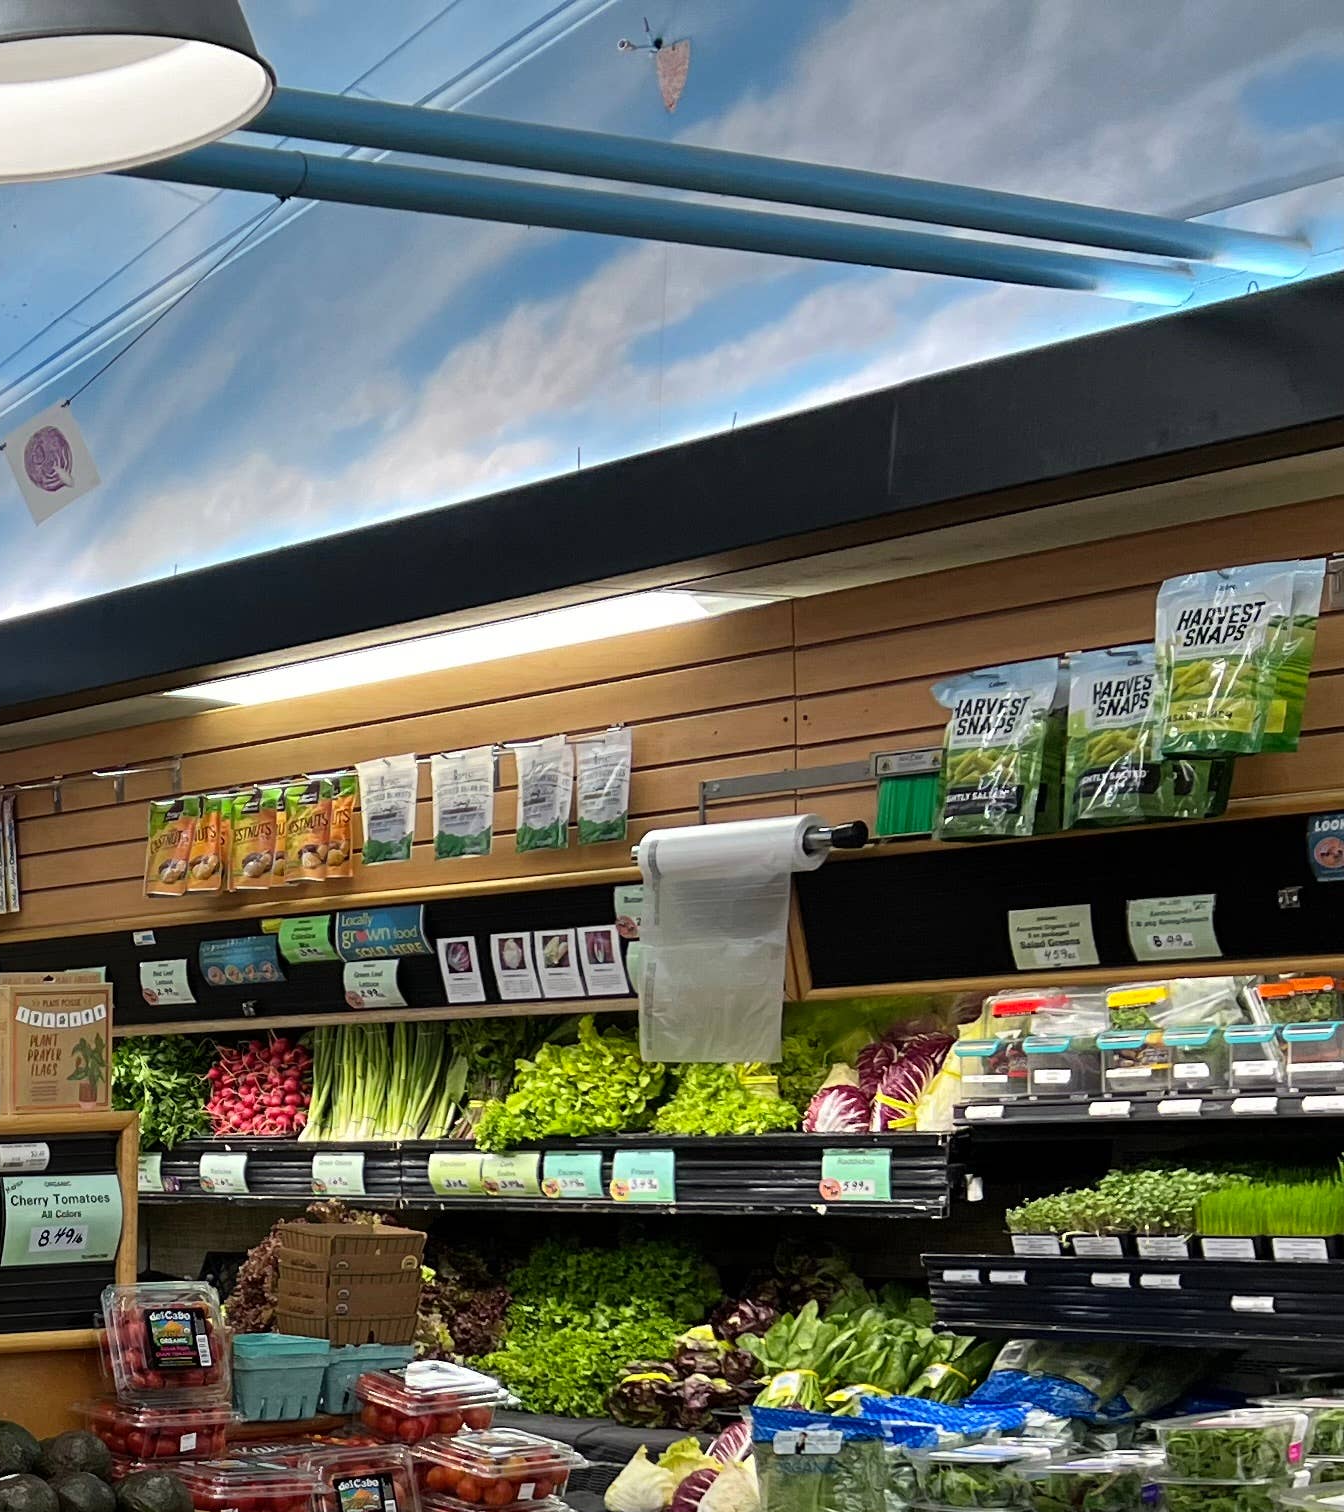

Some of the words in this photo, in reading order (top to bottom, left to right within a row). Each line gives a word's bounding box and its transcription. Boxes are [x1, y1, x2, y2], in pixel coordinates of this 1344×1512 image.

[1177, 601, 1266, 632] HARVEST
[1183, 624, 1248, 647] SNAPS
[1093, 674, 1154, 705] HARVES
[1096, 692, 1151, 718] SNAPS
[957, 718, 1014, 736] SNAPS
[341, 912, 373, 928] Locally
[394, 927, 419, 939] food
[29, 1034, 58, 1048] PLANT
[27, 1049, 63, 1063] PRAYER
[10, 1194, 50, 1208] Cherry
[52, 1192, 111, 1205] Tomatoes
[41, 1210, 53, 1219] All
[55, 1209, 83, 1219] Colors
